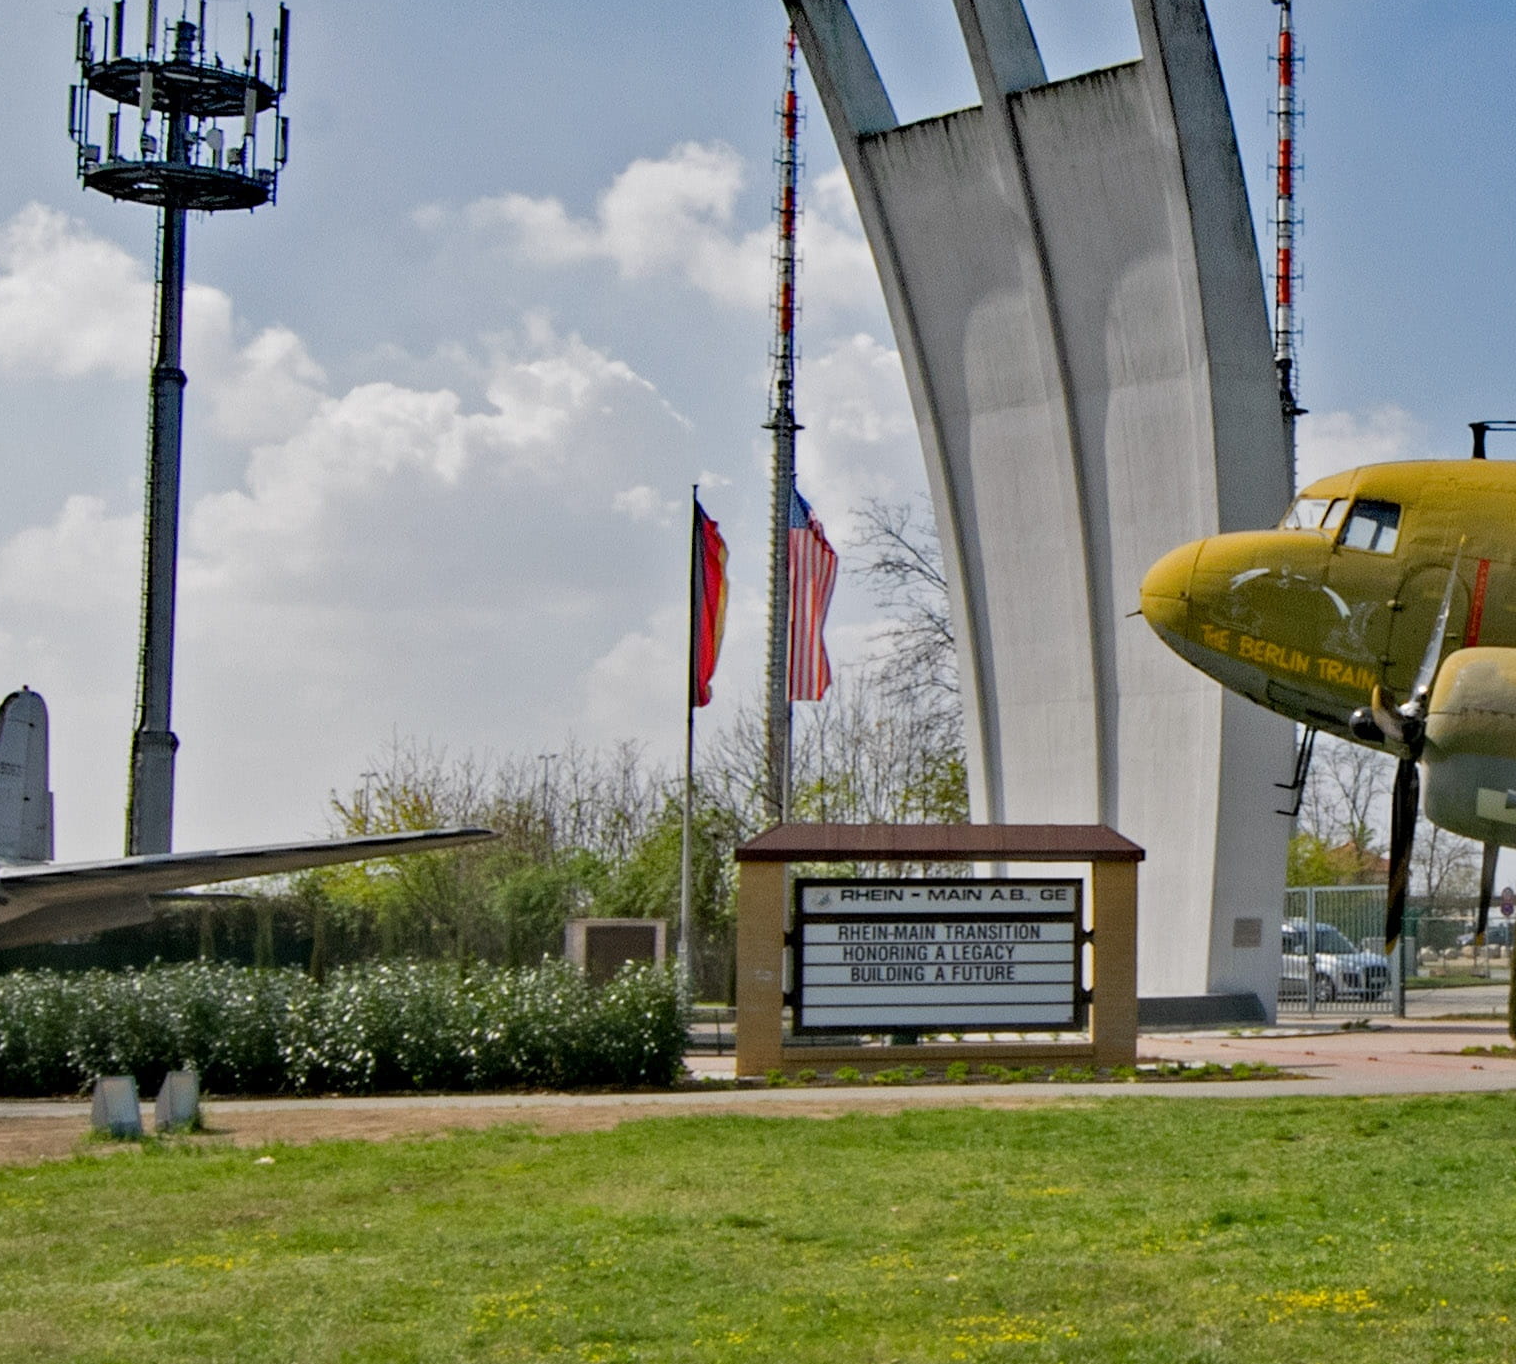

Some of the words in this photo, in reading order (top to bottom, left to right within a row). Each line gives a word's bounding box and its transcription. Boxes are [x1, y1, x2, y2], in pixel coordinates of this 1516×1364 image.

[1239, 635, 1310, 673] BERLIN
[1317, 658, 1377, 689] TRAIN
[840, 888, 904, 901] RHEIN
[927, 888, 982, 901] MAIN
[1040, 888, 1067, 901] GE
[838, 924, 935, 941] RHEIN-MAIN
[946, 924, 1041, 940] TRANSITION
[843, 945, 928, 962] HONORING
[935, 945, 946, 960] A
[952, 945, 1015, 960] LEGACY
[851, 966, 925, 982] BUILDING
[934, 966, 946, 981] A
[952, 965, 1015, 981] FUTURE
